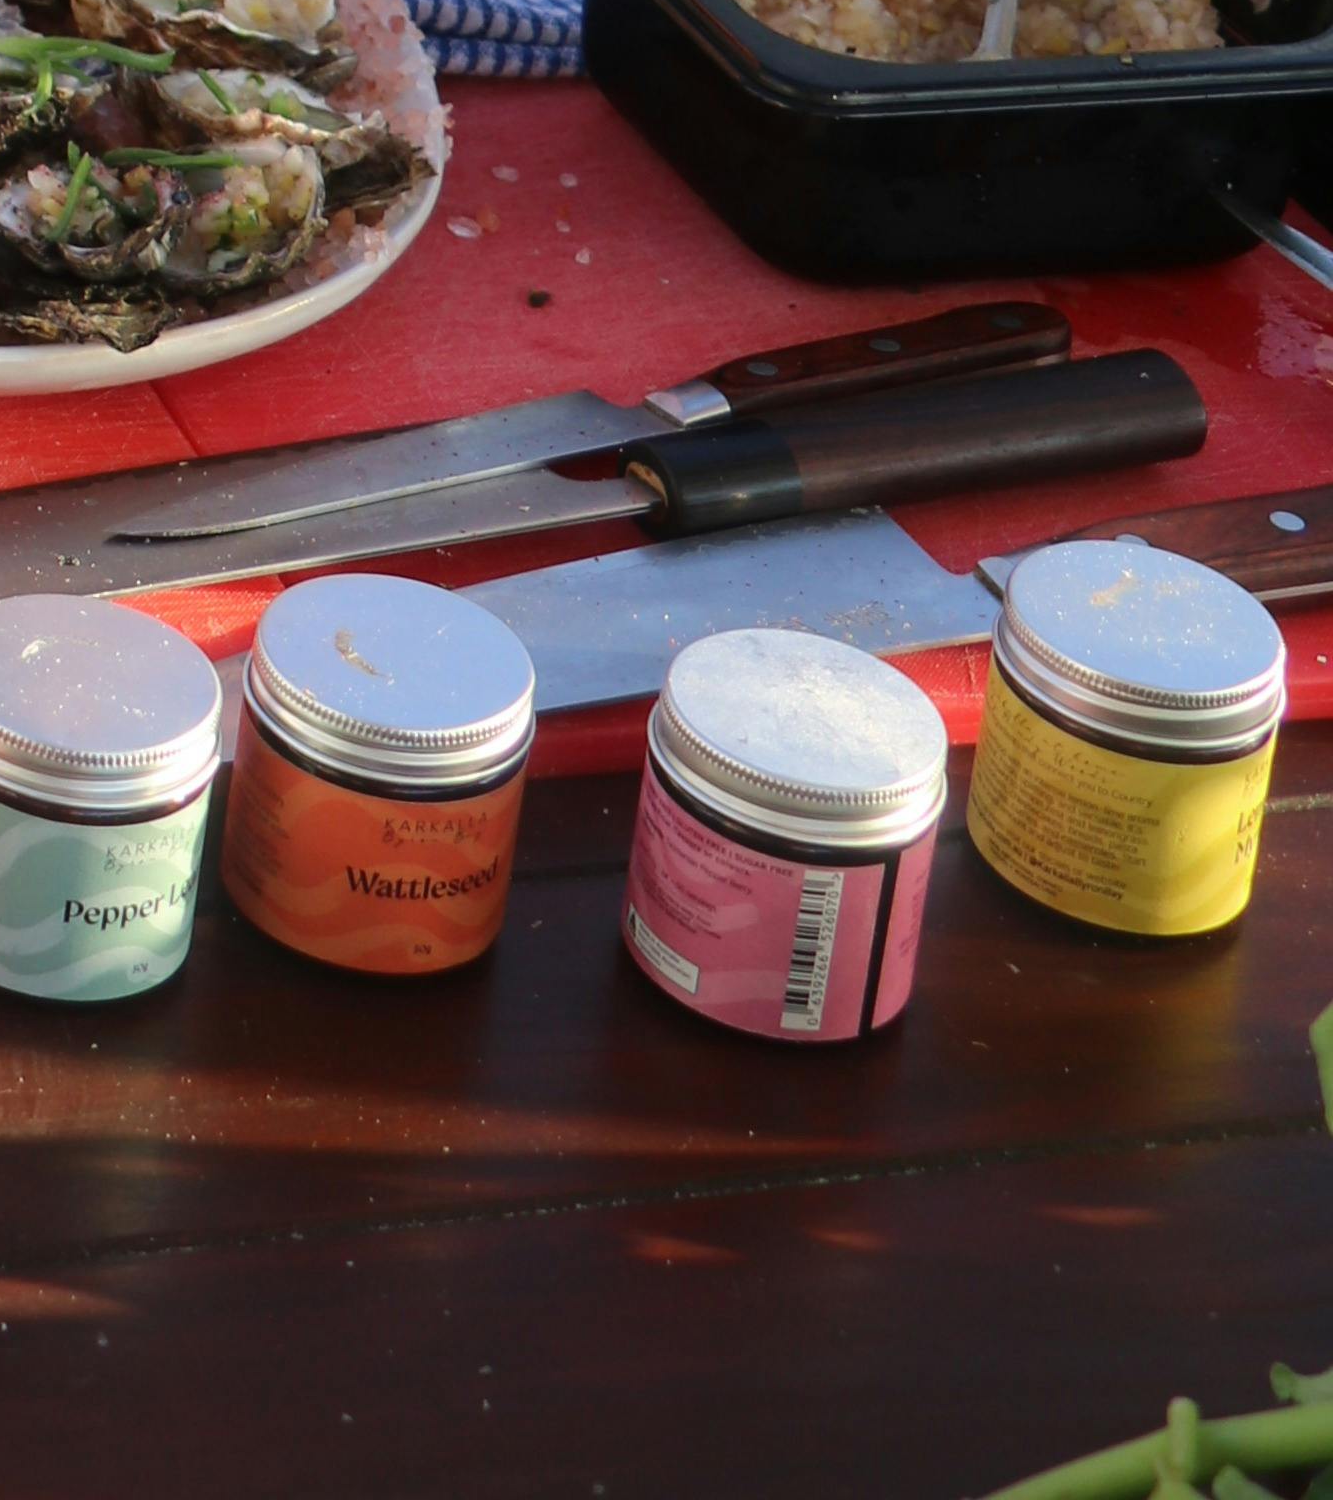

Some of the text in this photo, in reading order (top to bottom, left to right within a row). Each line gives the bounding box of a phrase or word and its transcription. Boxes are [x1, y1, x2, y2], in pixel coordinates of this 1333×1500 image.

[345, 856, 500, 900] Wattleseed
[63, 892, 165, 931] Pepper
[820, 890, 839, 941] 526070
[810, 954, 829, 1006] 639266
[807, 1016, 819, 1027] 0
